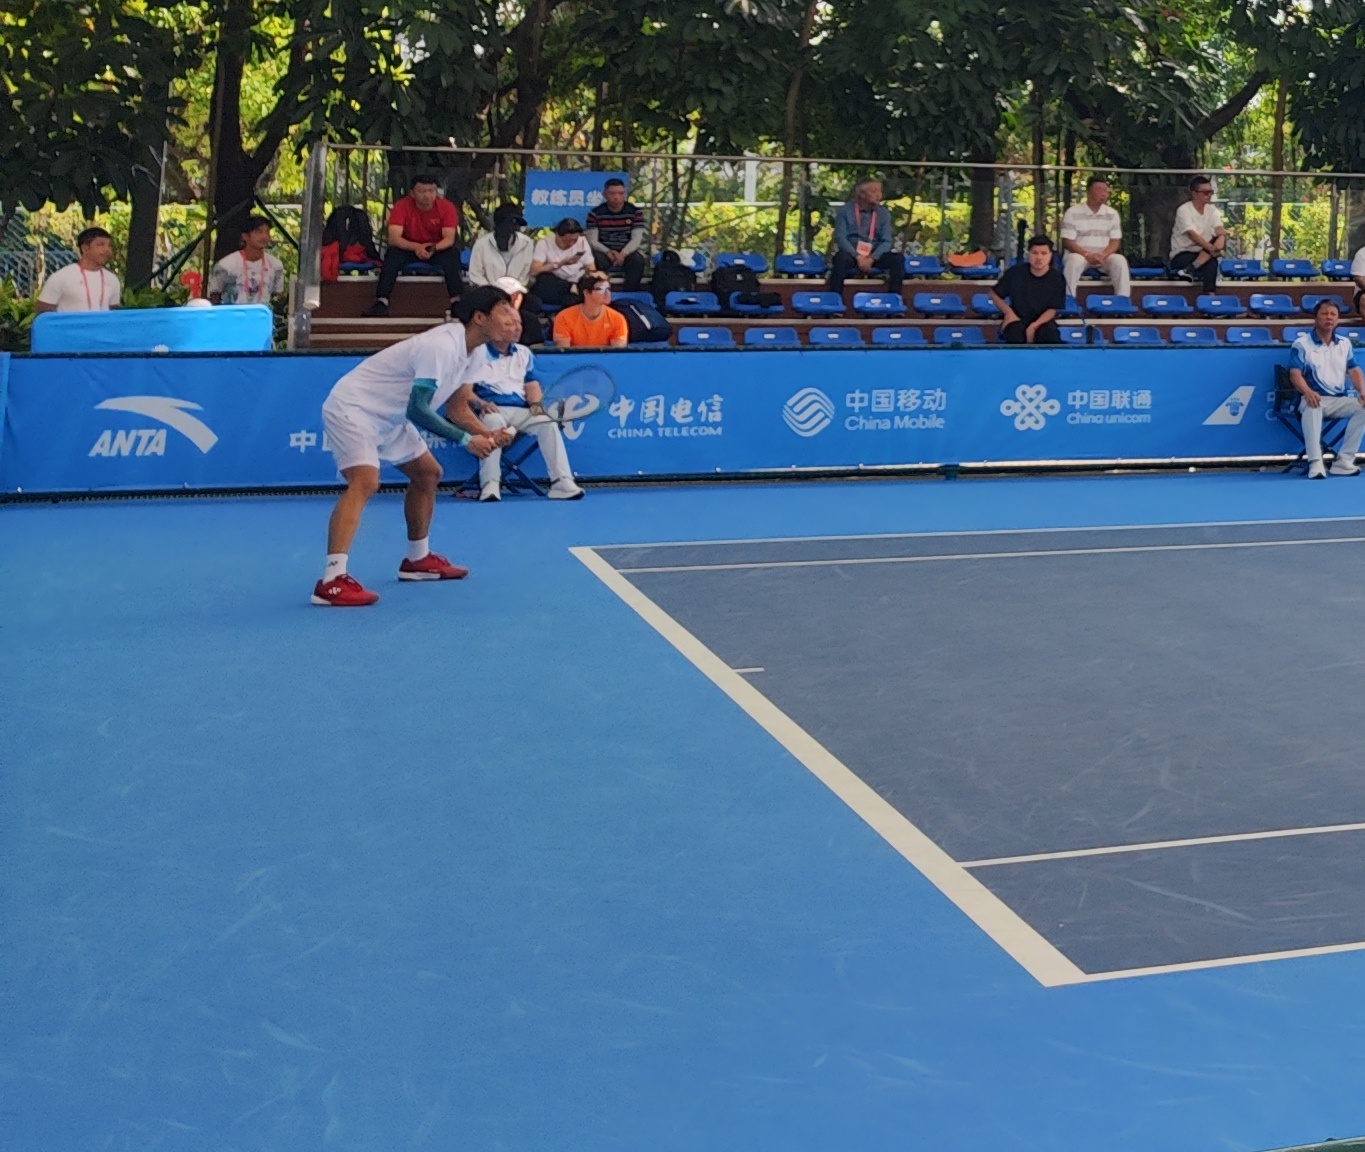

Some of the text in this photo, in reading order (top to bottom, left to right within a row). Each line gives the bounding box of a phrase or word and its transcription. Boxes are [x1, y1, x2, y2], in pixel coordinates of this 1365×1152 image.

[531, 189, 605, 206] 教练员坐
[845, 388, 947, 413] 中国移动
[1067, 390, 1152, 409] 中国联通
[609, 394, 723, 428] 中国电信
[1067, 412, 1103, 424] China
[845, 414, 945, 430] China Mobile
[608, 426, 722, 438] CHINA TELECOM
[88, 429, 167, 456] ANTA
